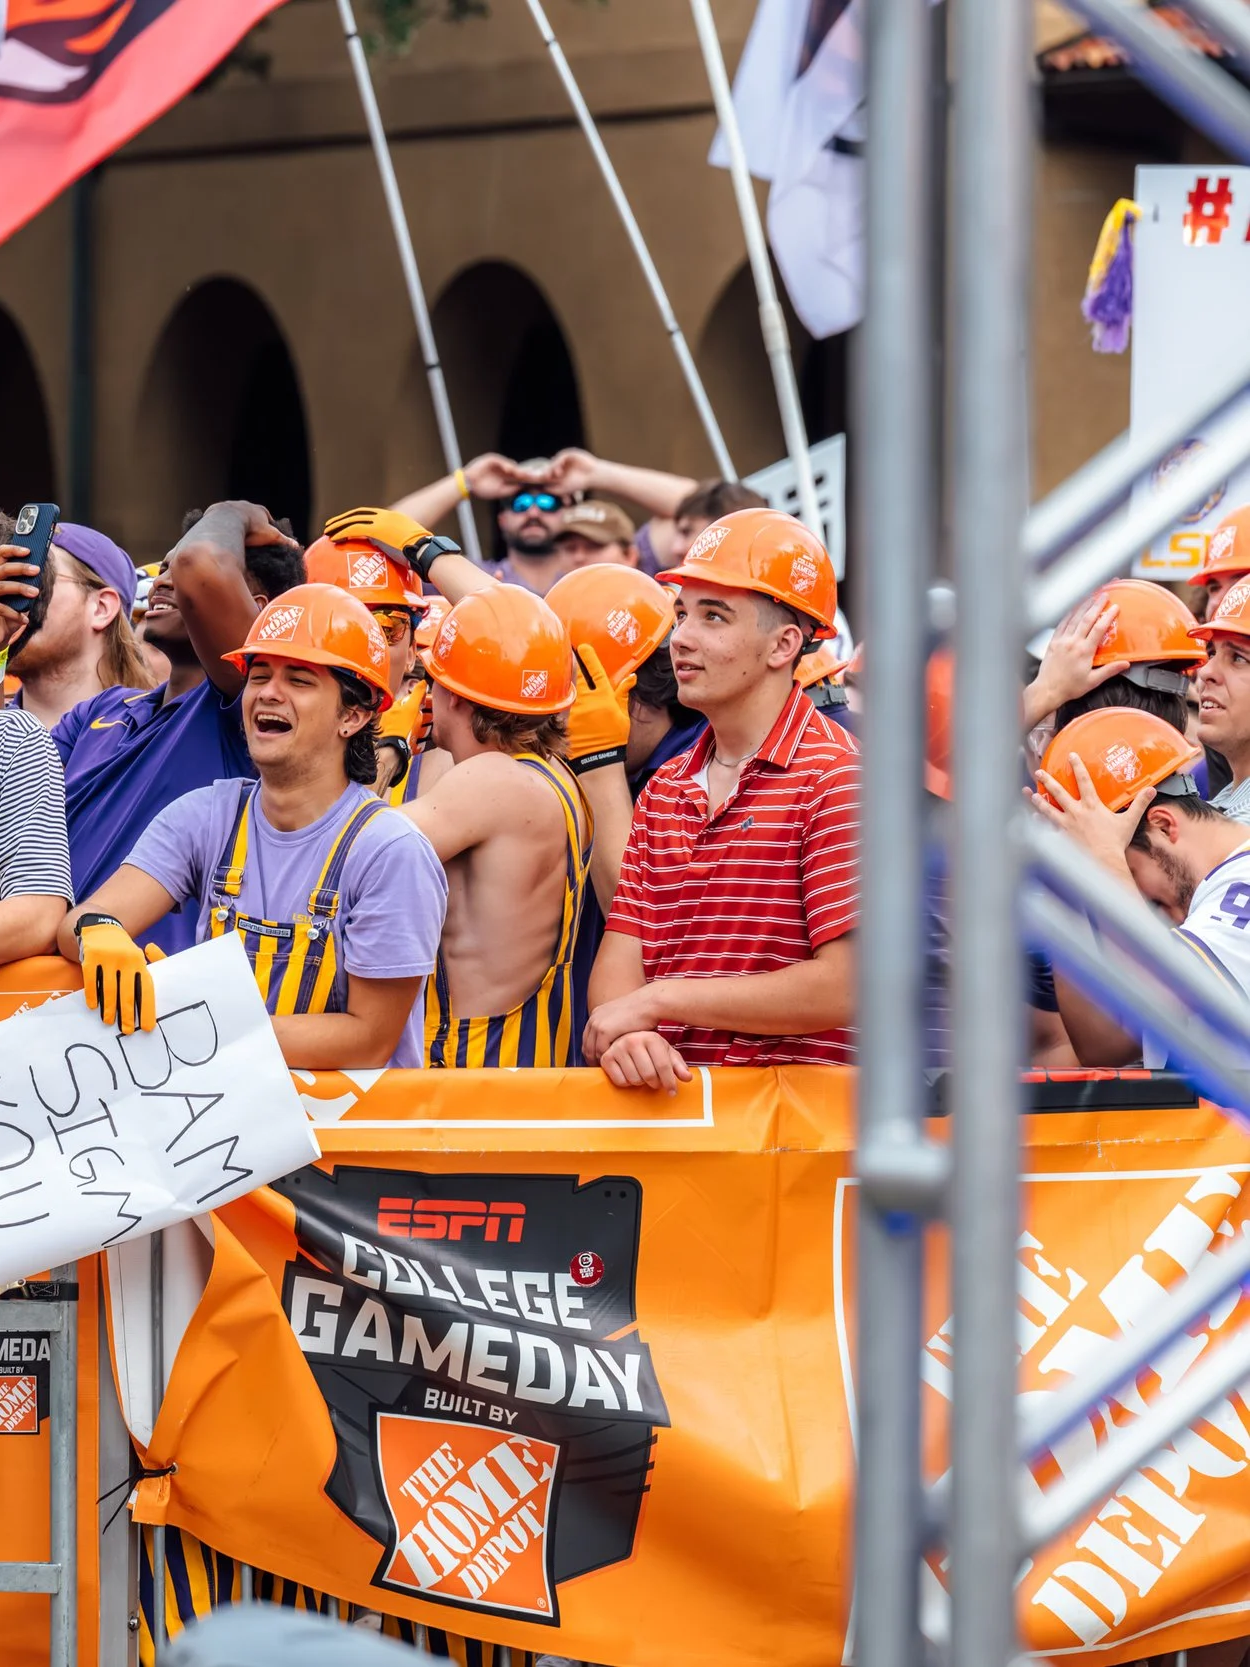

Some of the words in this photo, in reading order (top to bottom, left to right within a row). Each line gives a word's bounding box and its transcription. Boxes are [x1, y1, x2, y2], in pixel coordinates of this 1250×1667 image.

[350, 552, 385, 586] HOME
[1141, 533, 1213, 568] LS
[260, 607, 301, 639] HOME
[115, 1000, 253, 1204] BAM
[29, 1042, 142, 1248] SIGM
[377, 1197, 526, 1243] ESPN
[341, 1233, 591, 1330] COLLEGE
[0, 1366, 15, 1374] BUILT
[16, 1366, 24, 1374] BY
[290, 1275, 643, 1412] GAMEDAY
[3, 1397, 36, 1432] DEPOT
[424, 1388, 485, 1416] BUILT
[489, 1405, 518, 1425] BY
[399, 1441, 466, 1509] THE
[395, 1435, 554, 1590] HOME
[457, 1501, 544, 1600] DEPOT
